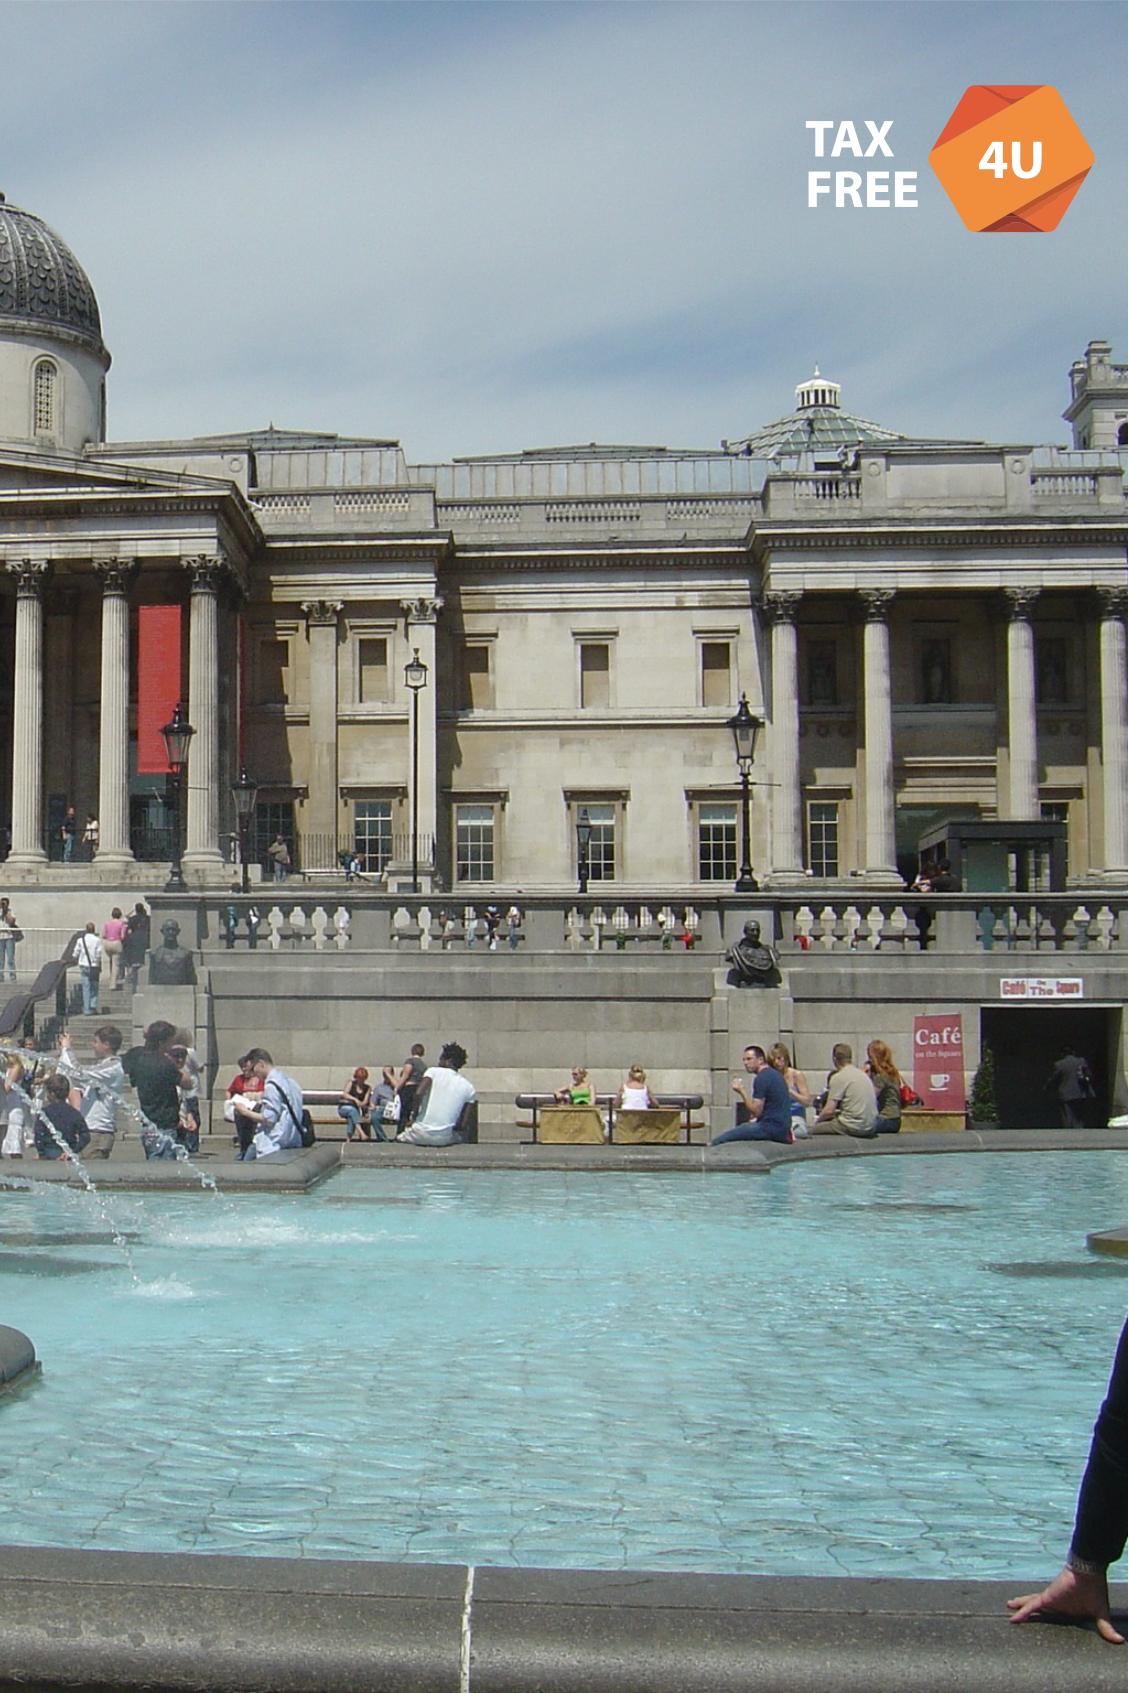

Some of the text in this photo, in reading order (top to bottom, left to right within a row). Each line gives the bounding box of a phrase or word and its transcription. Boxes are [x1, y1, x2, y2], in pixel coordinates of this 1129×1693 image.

[1002, 980, 1026, 995] Café
[1029, 986, 1054, 996] The
[915, 1026, 962, 1046] Café
[937, 1050, 961, 1059] Square
